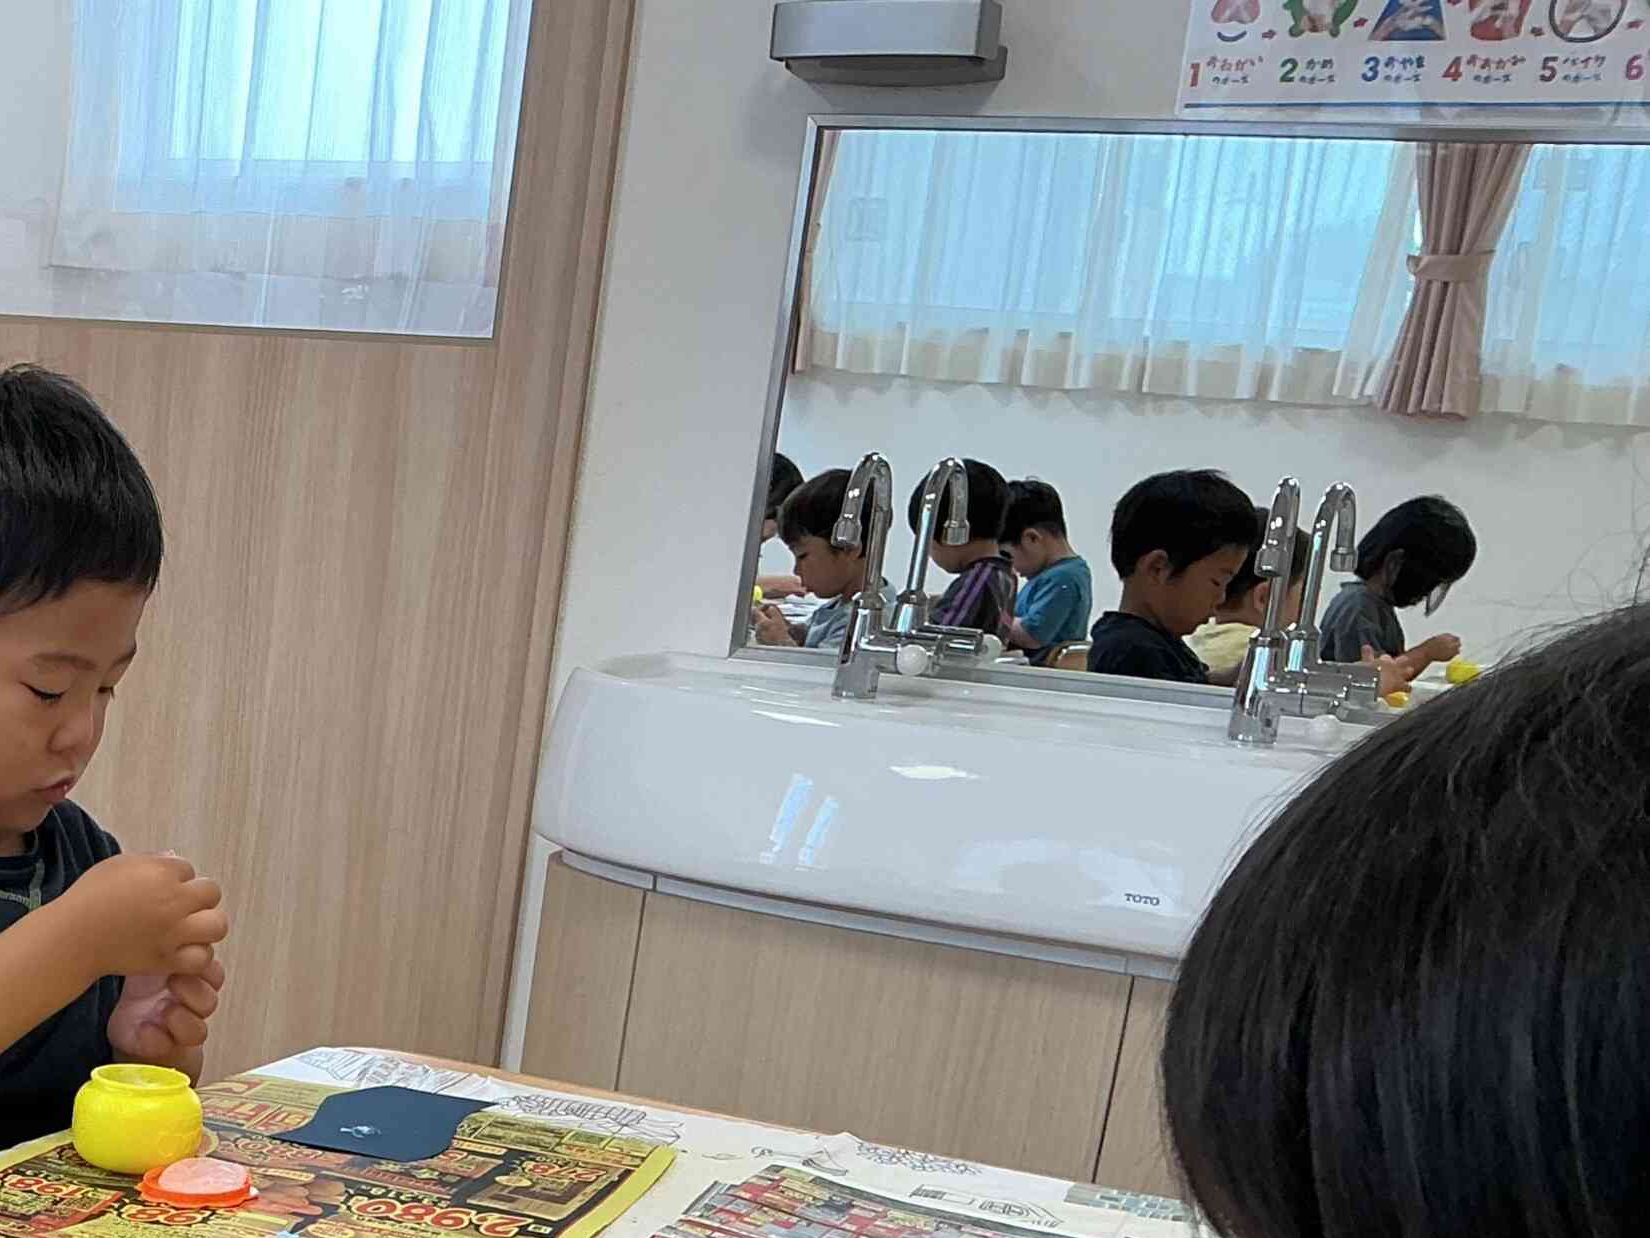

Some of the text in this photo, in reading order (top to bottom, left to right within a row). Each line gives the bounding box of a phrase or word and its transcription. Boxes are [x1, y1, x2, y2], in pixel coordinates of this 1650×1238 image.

[1189, 62, 1200, 87] 1
[1279, 57, 1298, 83] 2
[1304, 57, 1335, 72] かめ
[1361, 56, 1380, 82] 3
[1442, 56, 1464, 82] 4
[1538, 56, 1559, 82] 5
[1562, 55, 1608, 70] バイク
[1624, 54, 1644, 82] 6
[1124, 892, 1161, 906] TOTO
